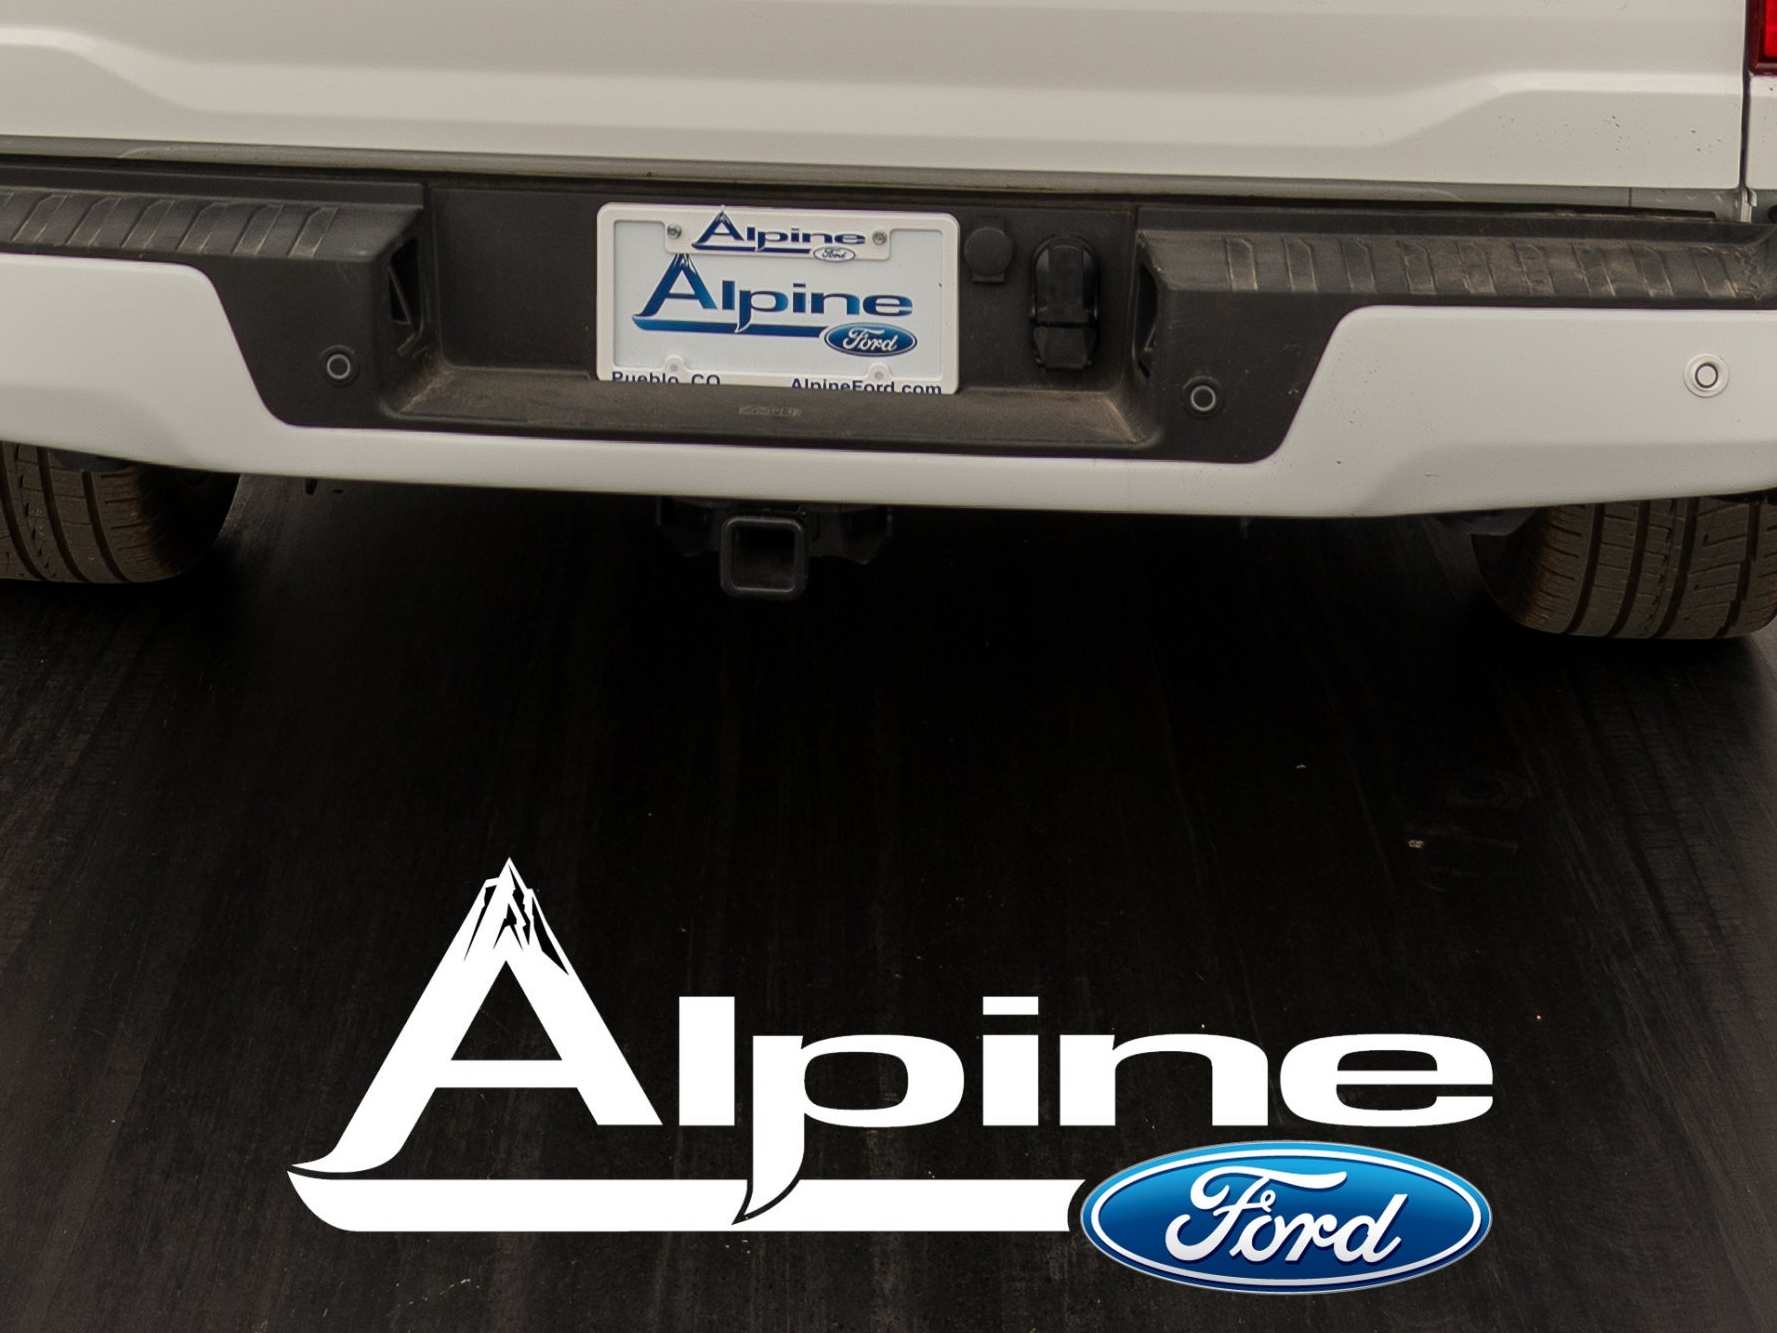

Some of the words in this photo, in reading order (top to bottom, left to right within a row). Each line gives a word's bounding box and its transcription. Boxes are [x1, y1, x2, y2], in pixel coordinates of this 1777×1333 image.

[691, 210, 866, 252] Alpine
[821, 247, 847, 259] Ford
[634, 253, 914, 333] Alpine
[842, 327, 898, 352] Ford
[691, 374, 720, 385] CO
[791, 378, 942, 395] AlineFordcom
